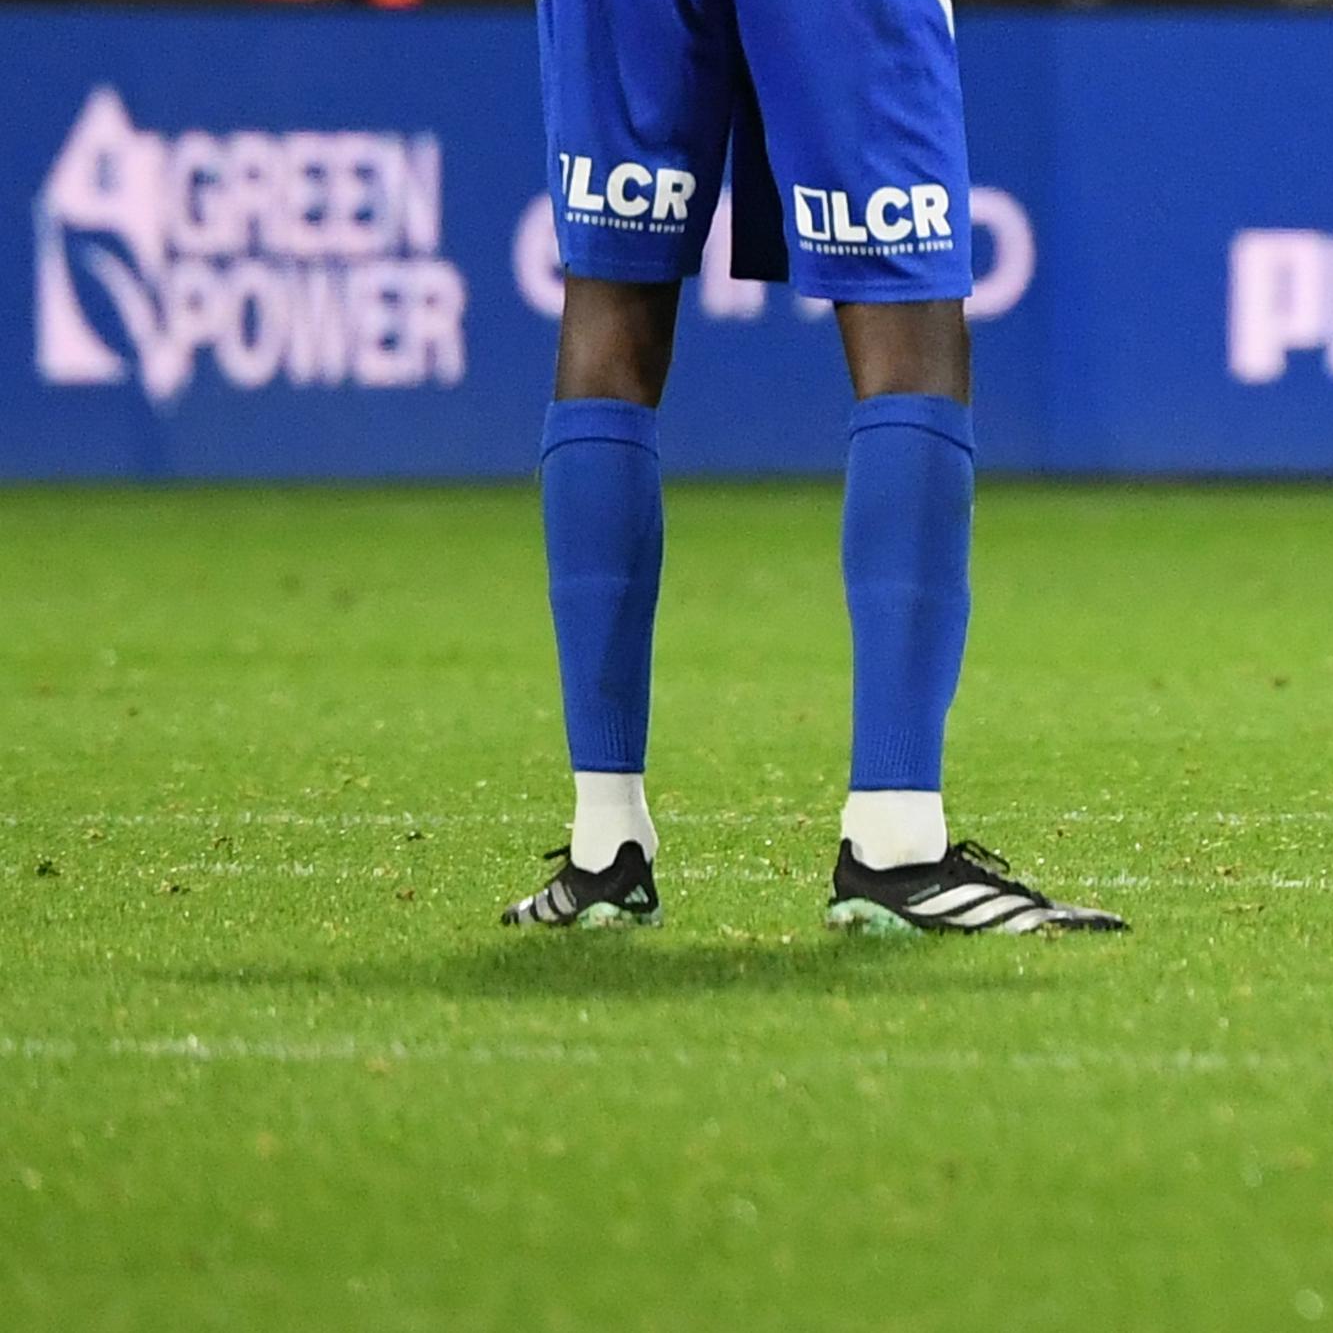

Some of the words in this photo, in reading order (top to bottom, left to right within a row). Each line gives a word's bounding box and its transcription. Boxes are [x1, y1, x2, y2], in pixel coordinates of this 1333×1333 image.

[170, 130, 442, 255] GREEN
[568, 155, 697, 220] LCR
[831, 184, 953, 243] LCR
[176, 262, 467, 387] POWER
